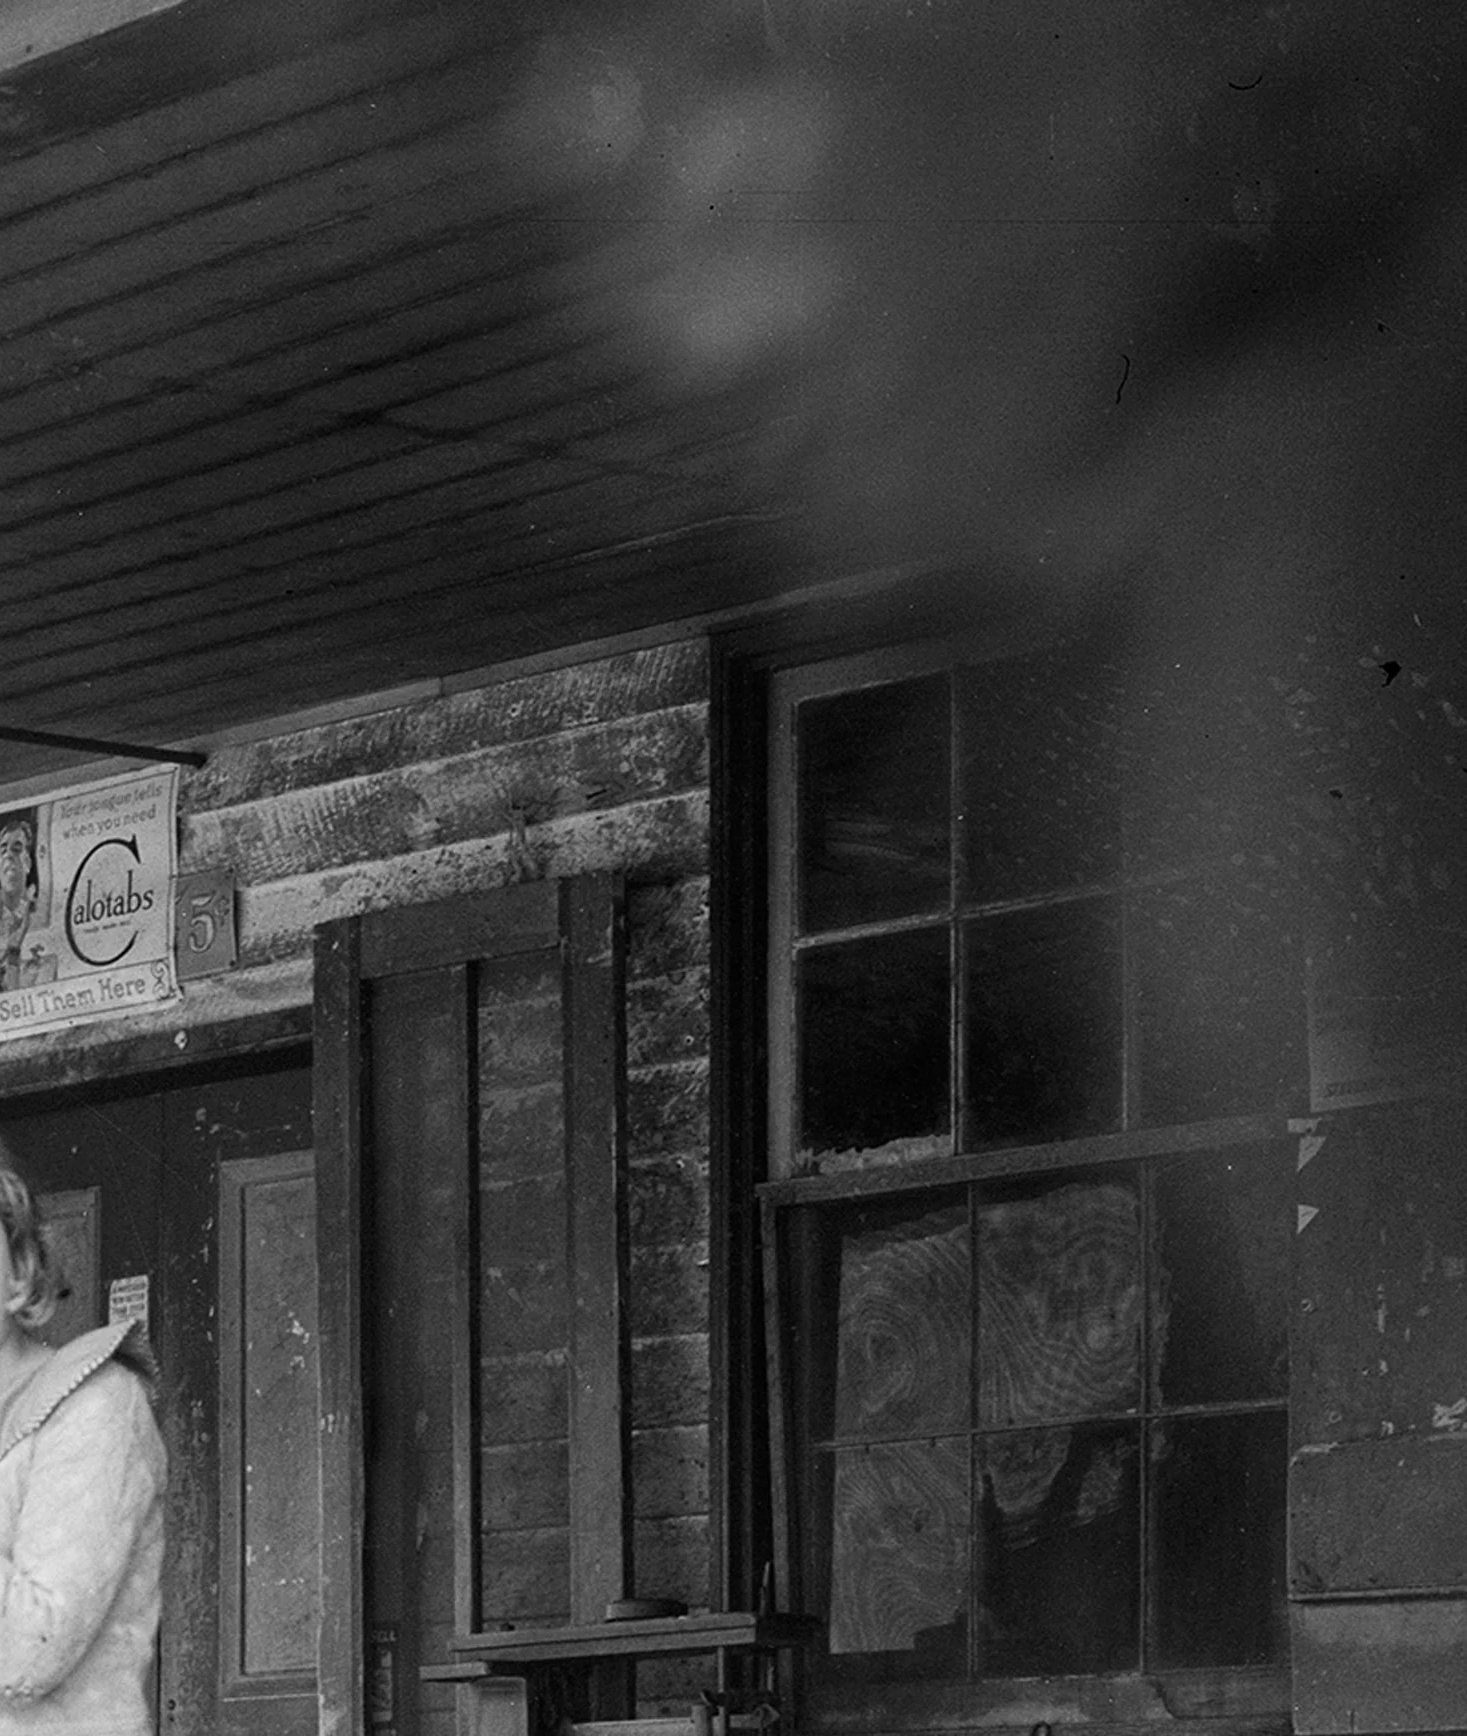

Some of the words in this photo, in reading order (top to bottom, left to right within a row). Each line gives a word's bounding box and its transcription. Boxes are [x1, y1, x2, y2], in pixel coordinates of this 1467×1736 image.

[134, 781, 164, 801] tells
[96, 816, 121, 836] you
[123, 803, 156, 825] need
[64, 833, 155, 967] Calotabs
[41, 983, 96, 1014] Them
[98, 976, 146, 1005] Here
